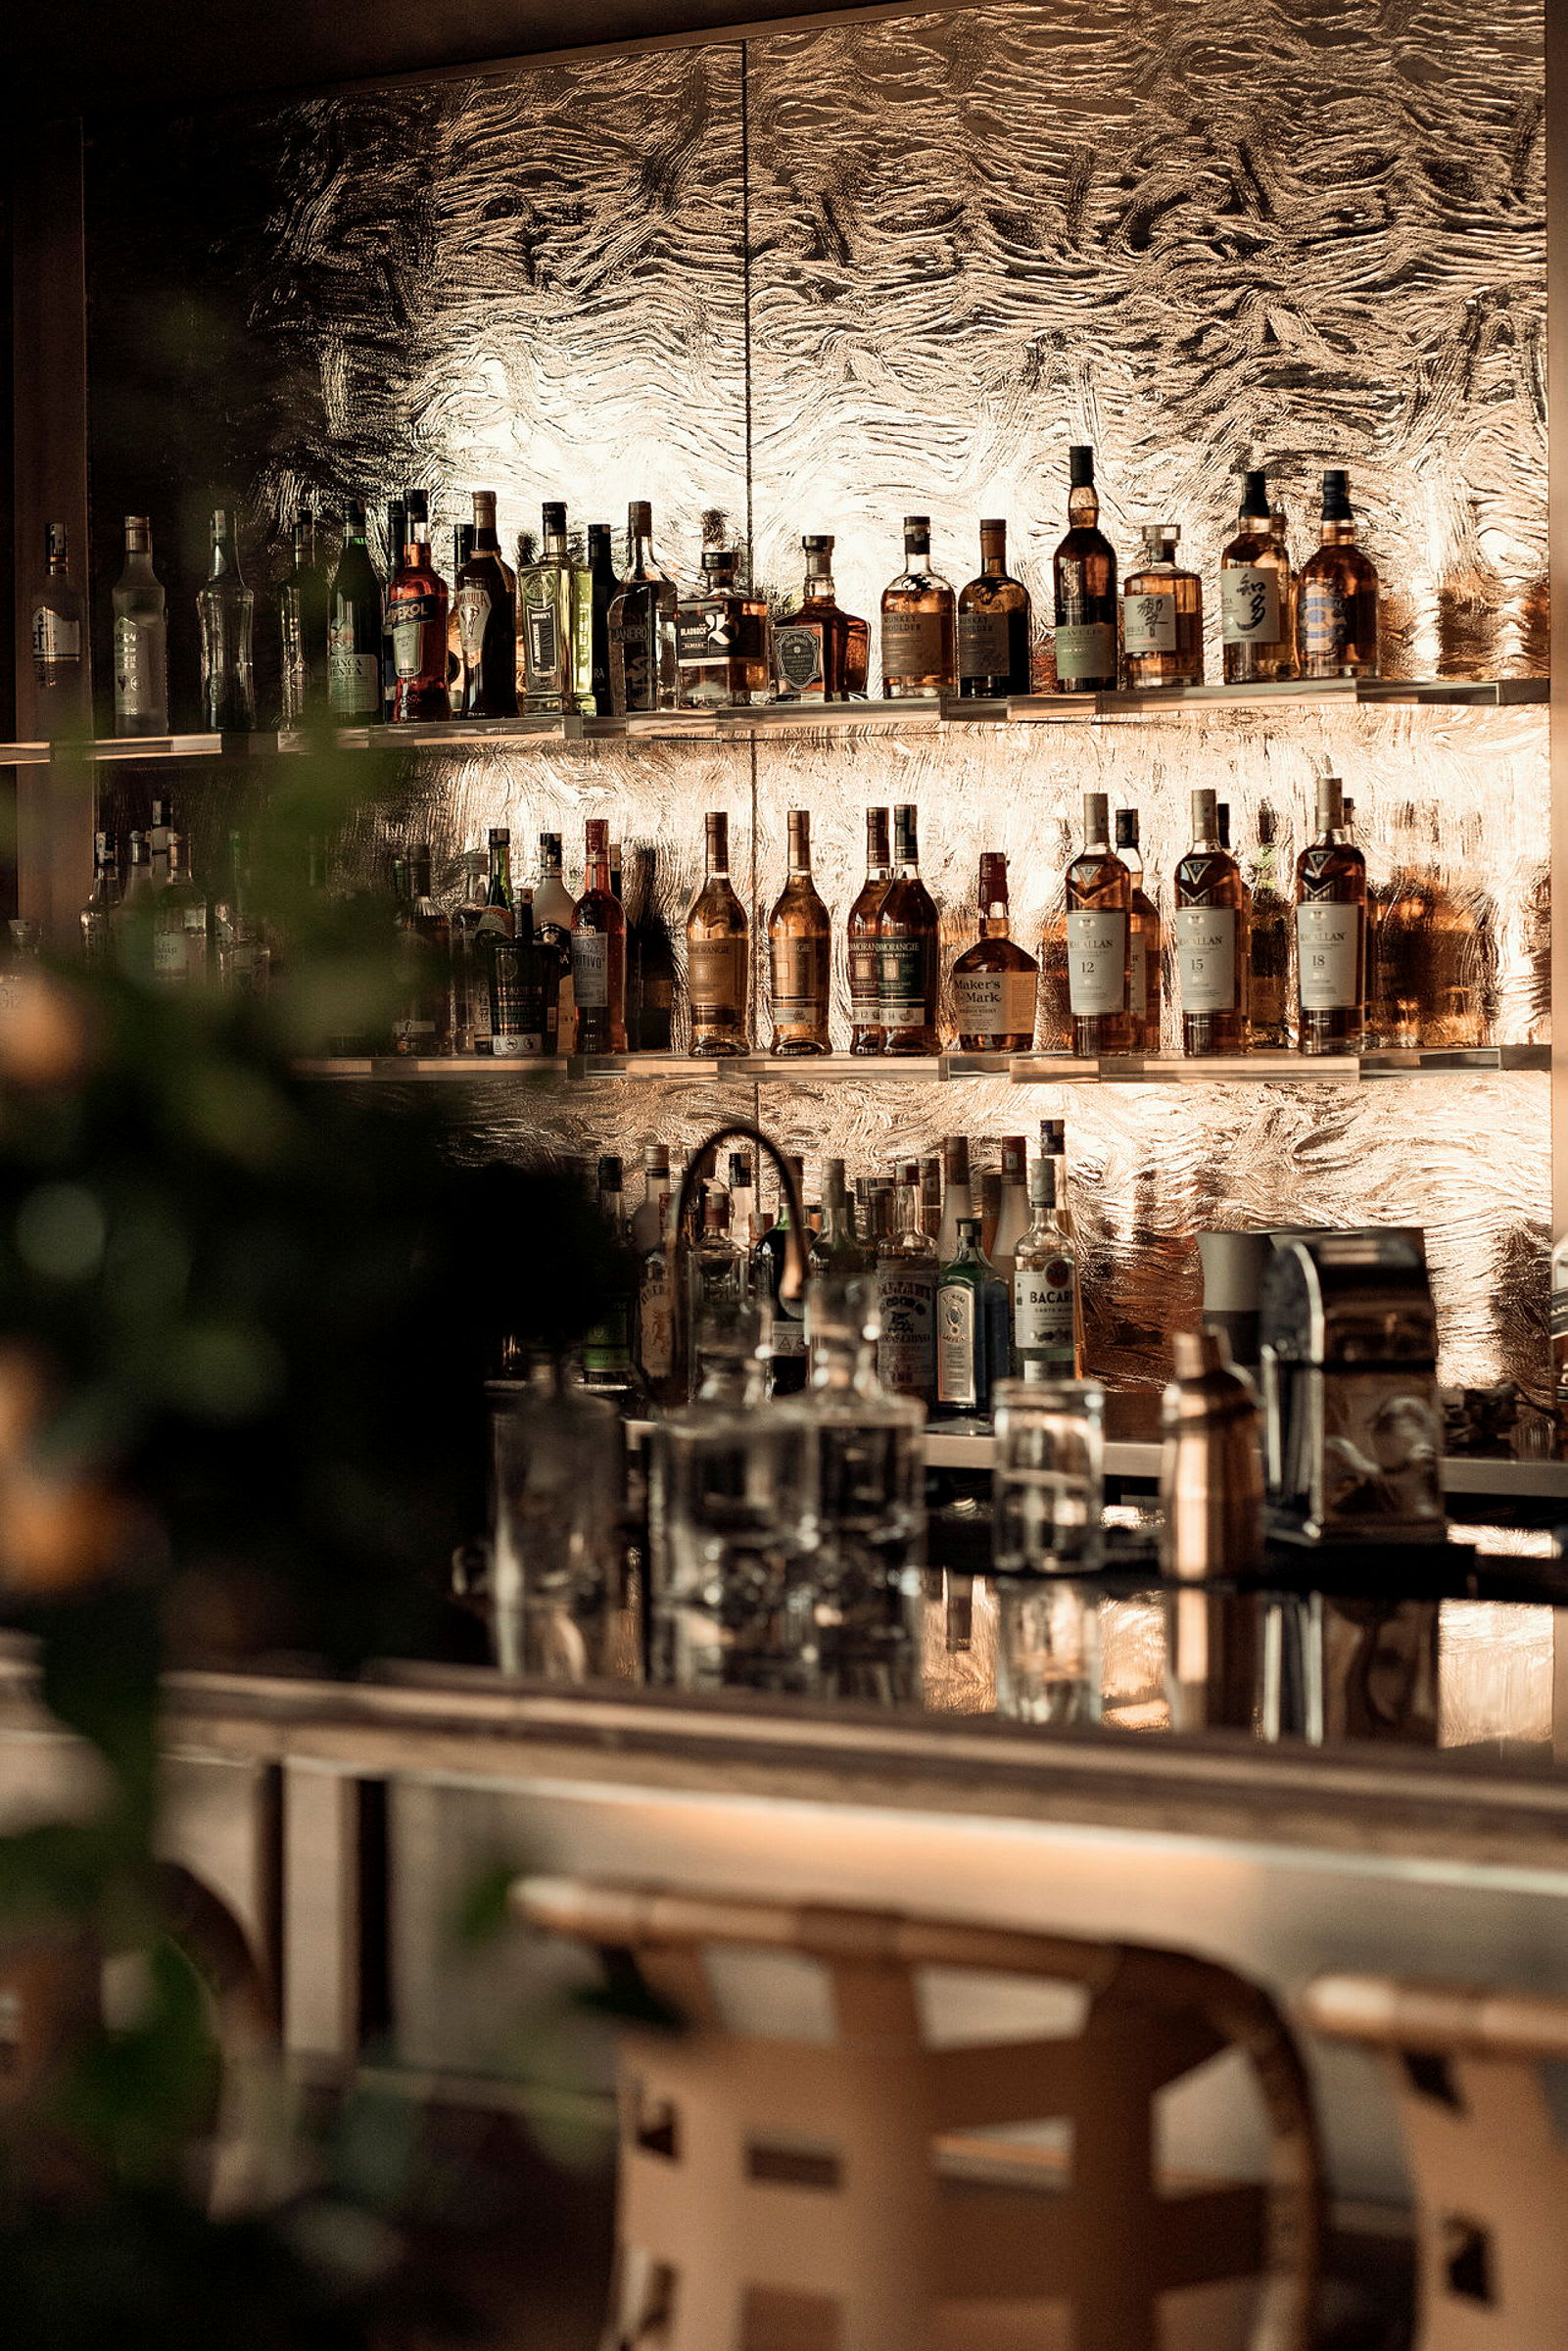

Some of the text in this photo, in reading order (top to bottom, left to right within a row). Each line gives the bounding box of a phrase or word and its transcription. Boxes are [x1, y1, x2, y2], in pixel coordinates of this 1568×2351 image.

[391, 602, 428, 620] PEROL
[1191, 958, 1204, 970] 15
[1312, 955, 1325, 966] 18
[1081, 962, 1095, 973] 12
[954, 980, 1001, 990] Maker's
[966, 992, 1000, 1002] Mark
[1029, 1290, 1073, 1304] BACAR
